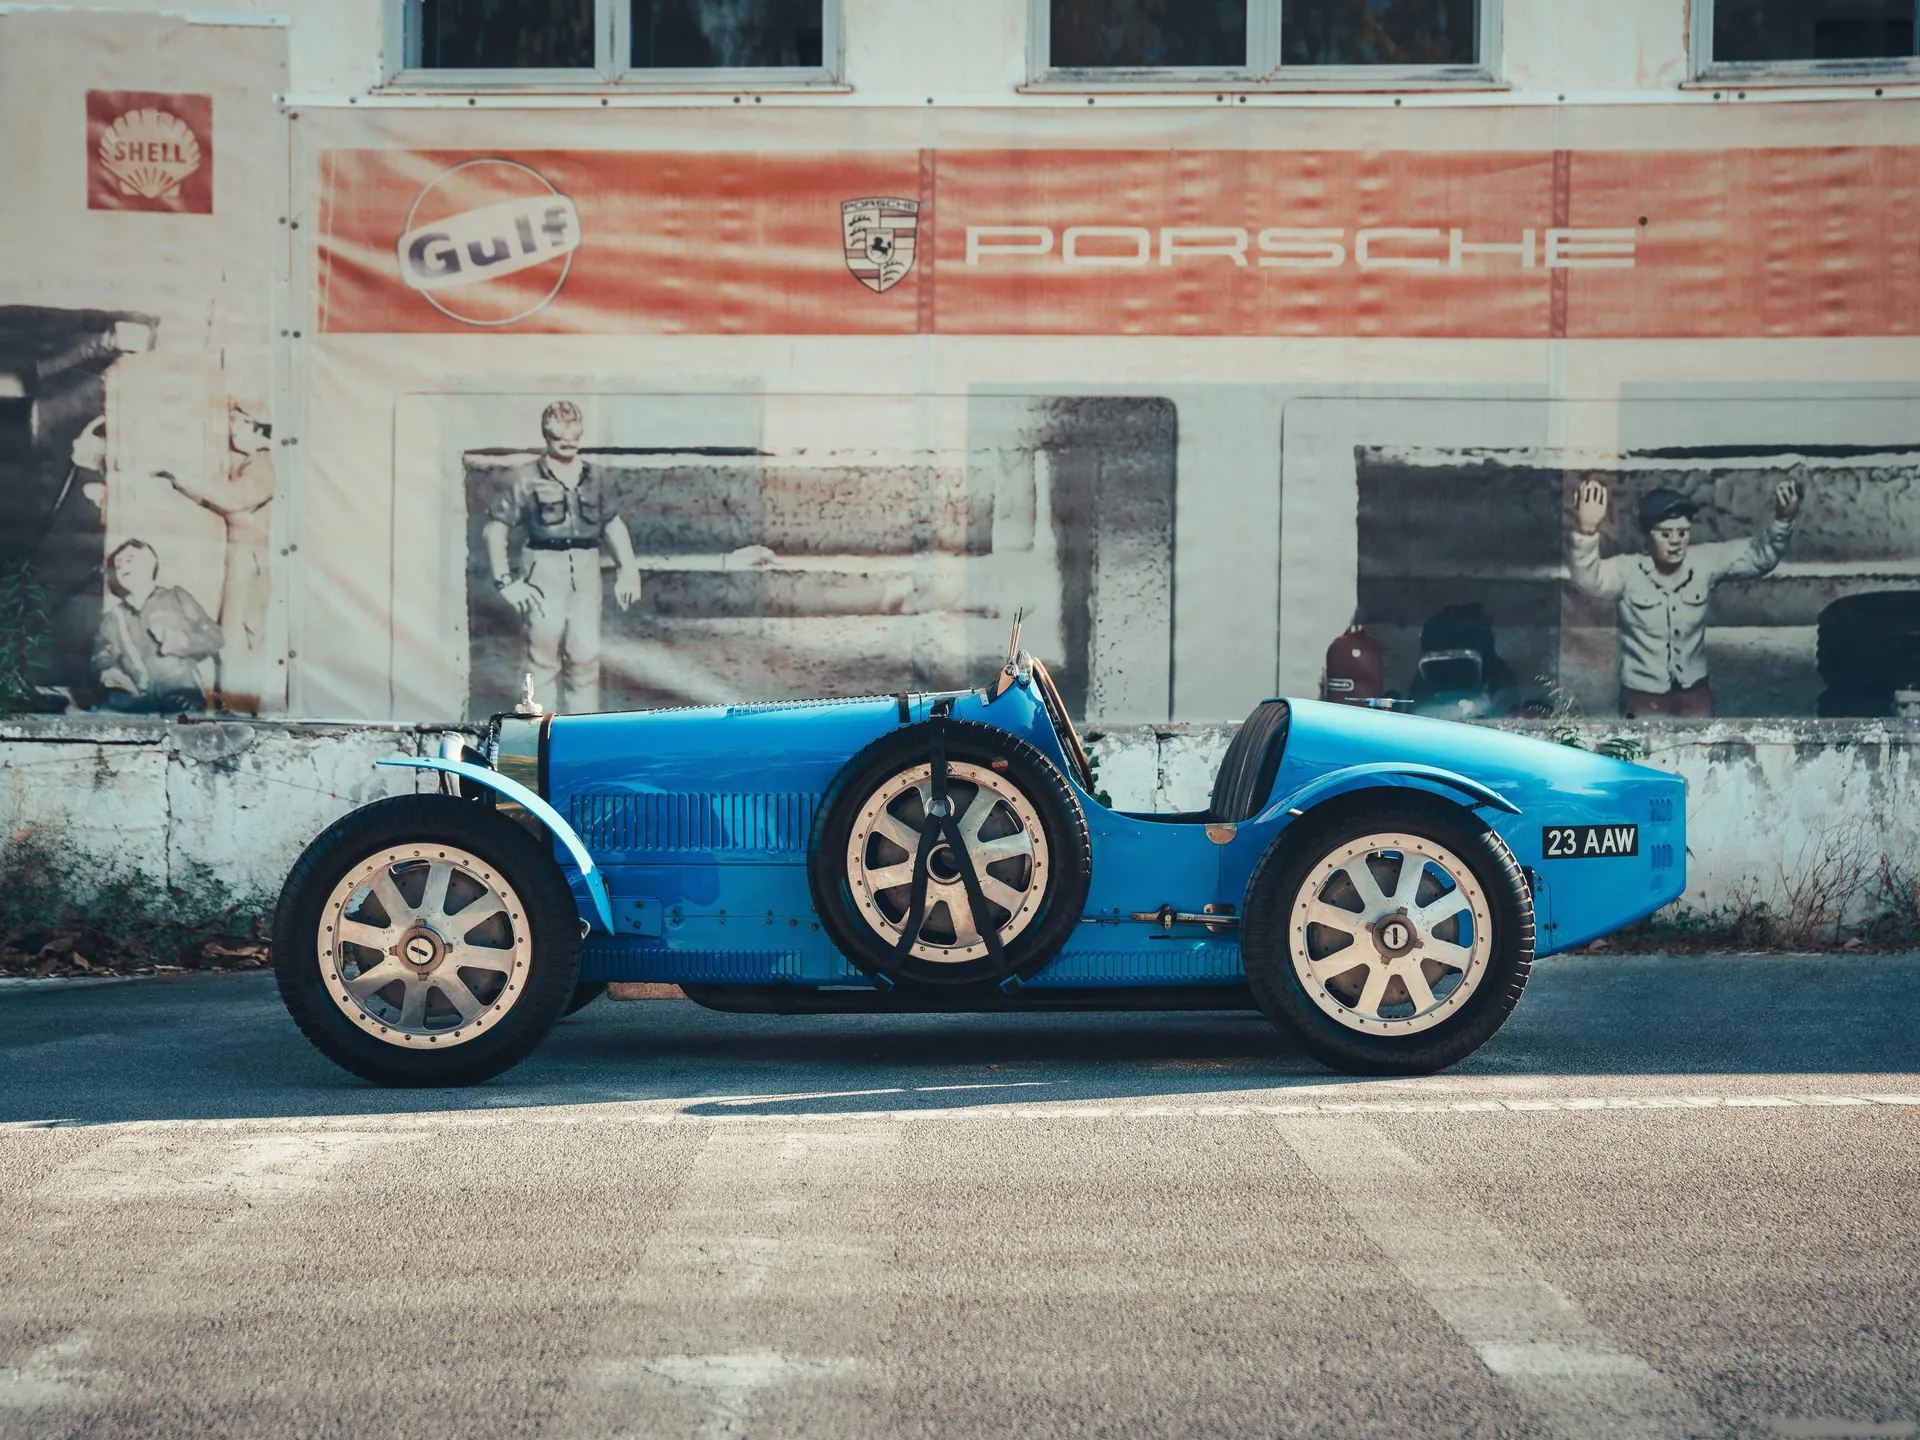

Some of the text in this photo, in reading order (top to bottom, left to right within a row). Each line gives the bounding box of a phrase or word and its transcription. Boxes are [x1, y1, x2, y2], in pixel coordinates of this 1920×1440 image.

[114, 141, 186, 163] SHELL
[844, 200, 915, 211] PORSCHE
[408, 205, 567, 278] Gulf
[965, 226, 1637, 269] PORSCHE
[1548, 827, 1635, 856] 23 AAW
